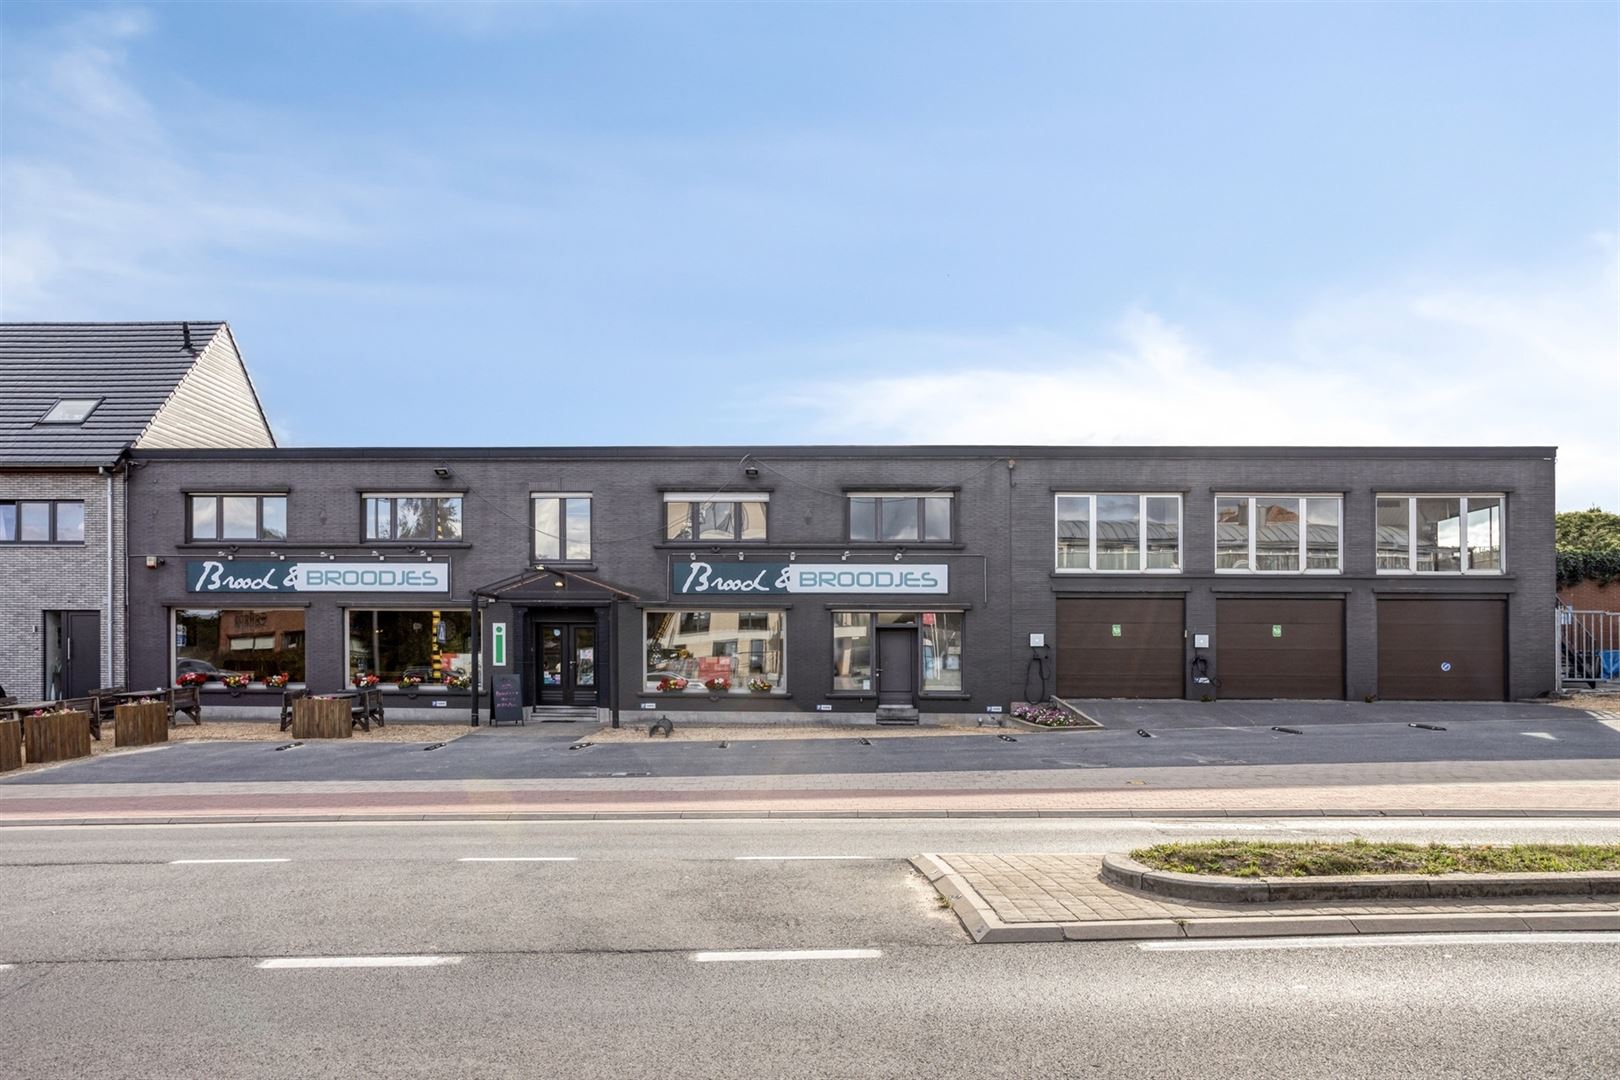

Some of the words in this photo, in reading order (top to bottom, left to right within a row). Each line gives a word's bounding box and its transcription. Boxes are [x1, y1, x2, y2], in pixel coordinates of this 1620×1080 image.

[195, 561, 278, 591] Brood
[306, 570, 438, 586] BROODJES
[682, 562, 770, 593] Brood
[799, 571, 938, 588] BROODJES
